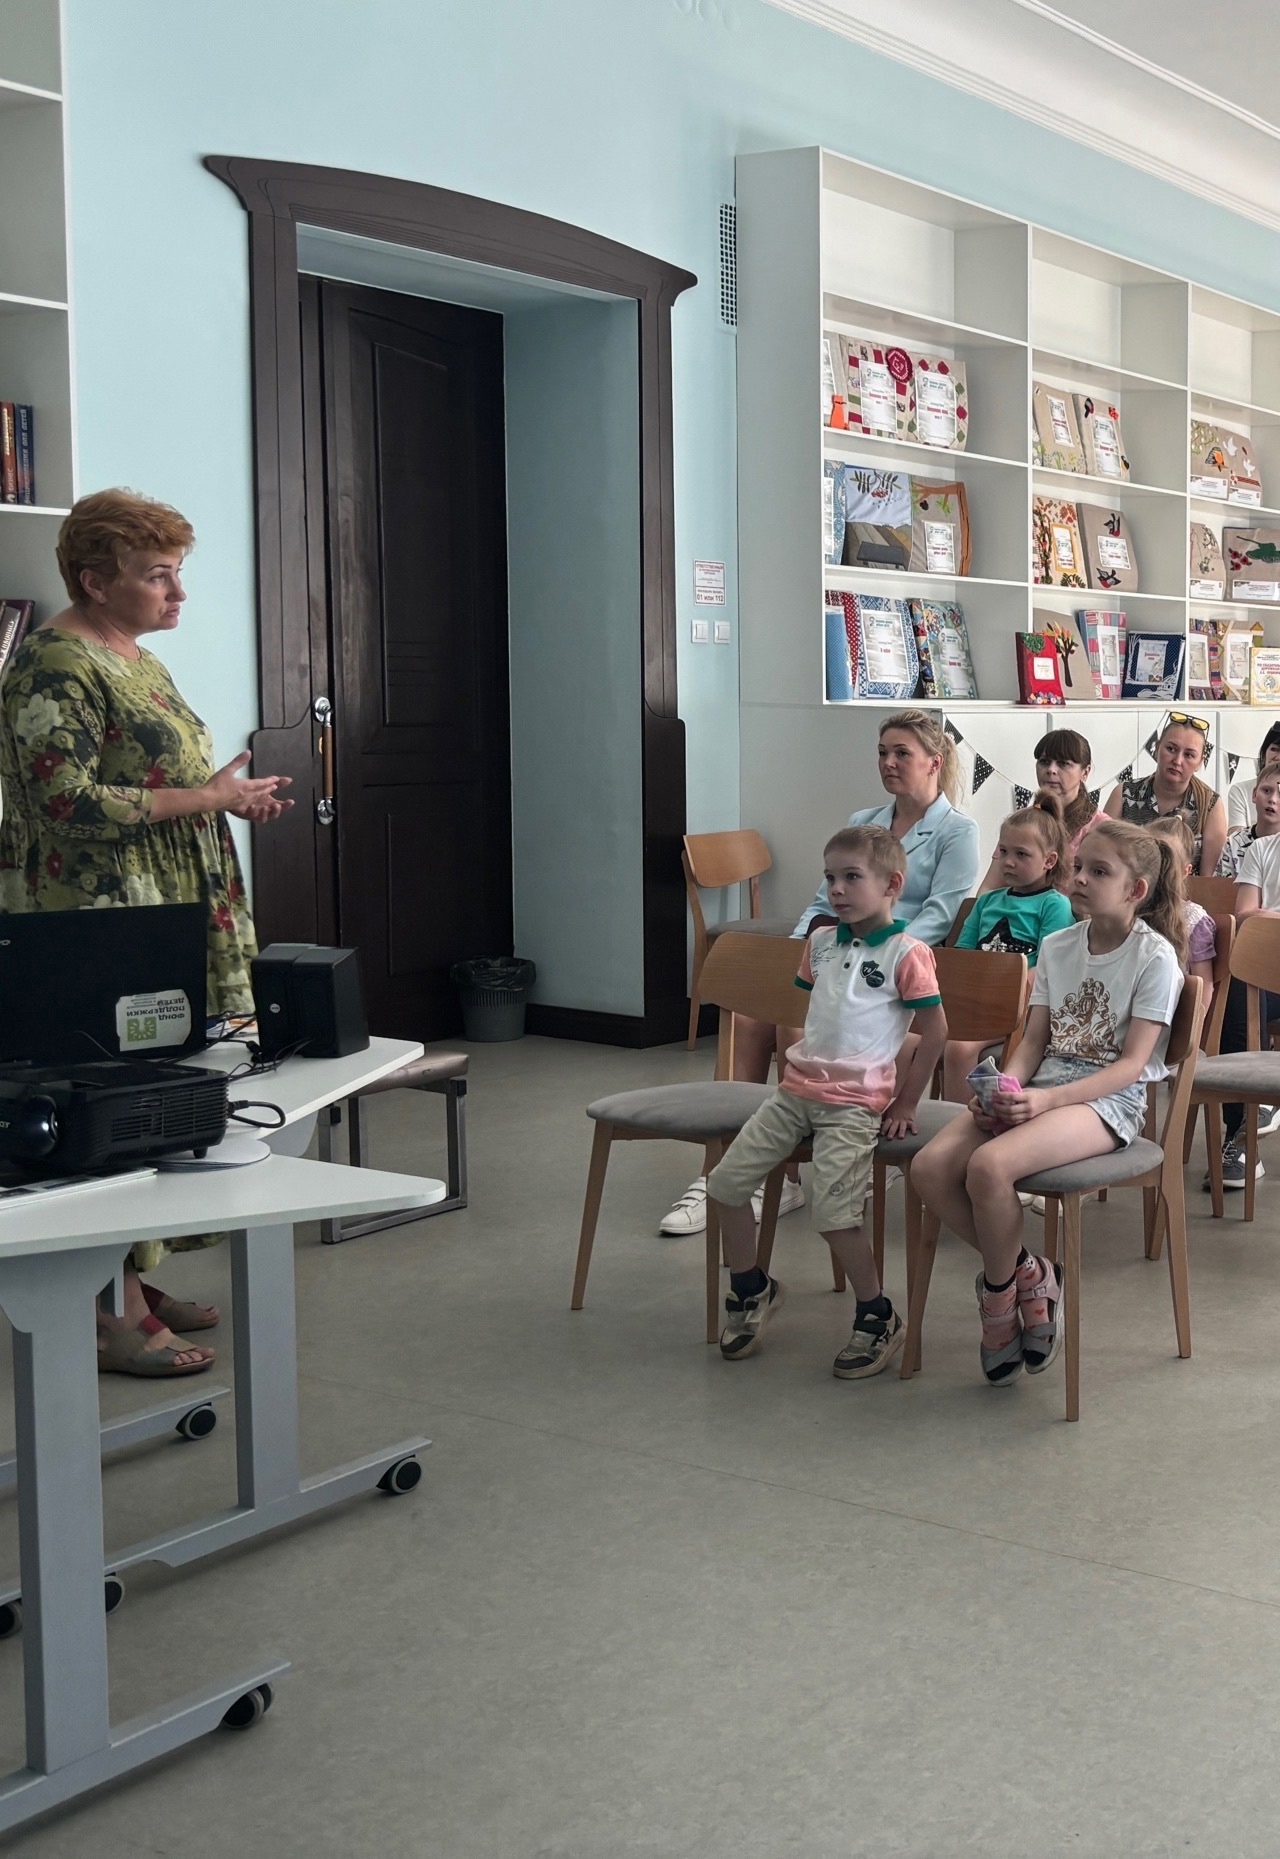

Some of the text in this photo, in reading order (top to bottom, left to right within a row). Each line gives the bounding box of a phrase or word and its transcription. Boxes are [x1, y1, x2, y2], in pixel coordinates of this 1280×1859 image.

[20, 408, 28, 430] ДЕТЕЙ
[157, 997, 185, 1006] ДЕТЕЙ
[127, 1006, 185, 1017] ПОДДЕРЖКИ
[158, 1013, 185, 1021] ФОНД
